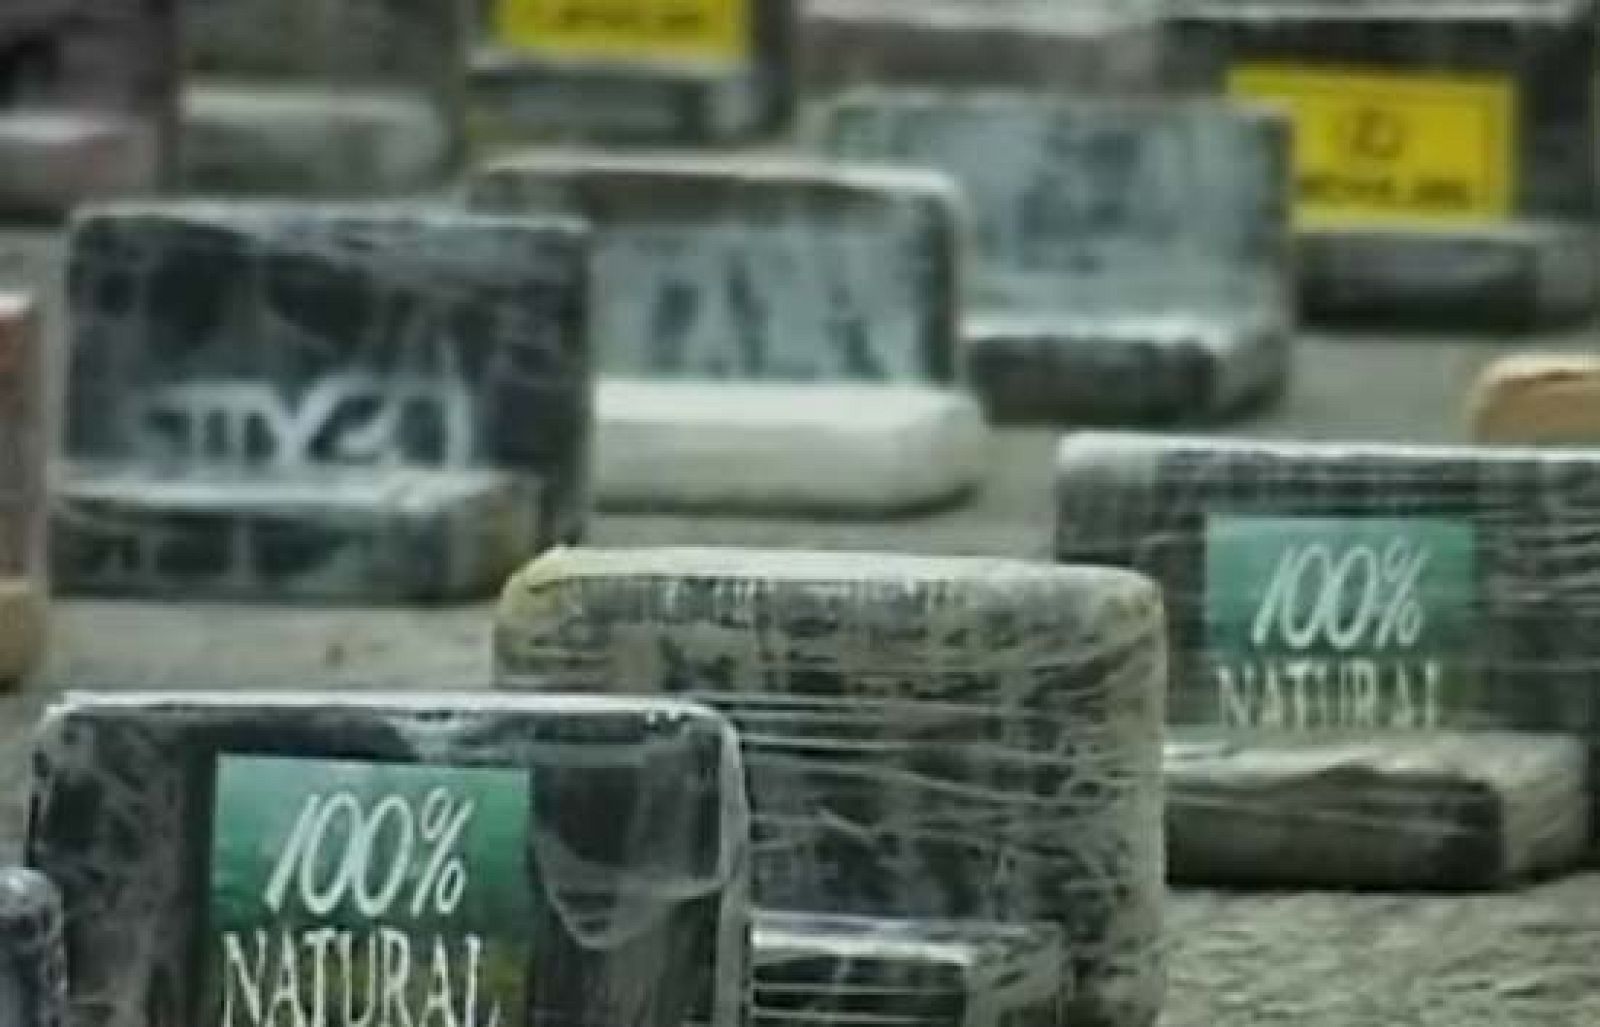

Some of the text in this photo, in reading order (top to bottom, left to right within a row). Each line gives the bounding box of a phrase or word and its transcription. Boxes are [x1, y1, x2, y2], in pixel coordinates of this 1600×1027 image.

[1253, 539, 1430, 649] 100%
[264, 787, 474, 917] 100%
[222, 928, 500, 1027] NATURAL
